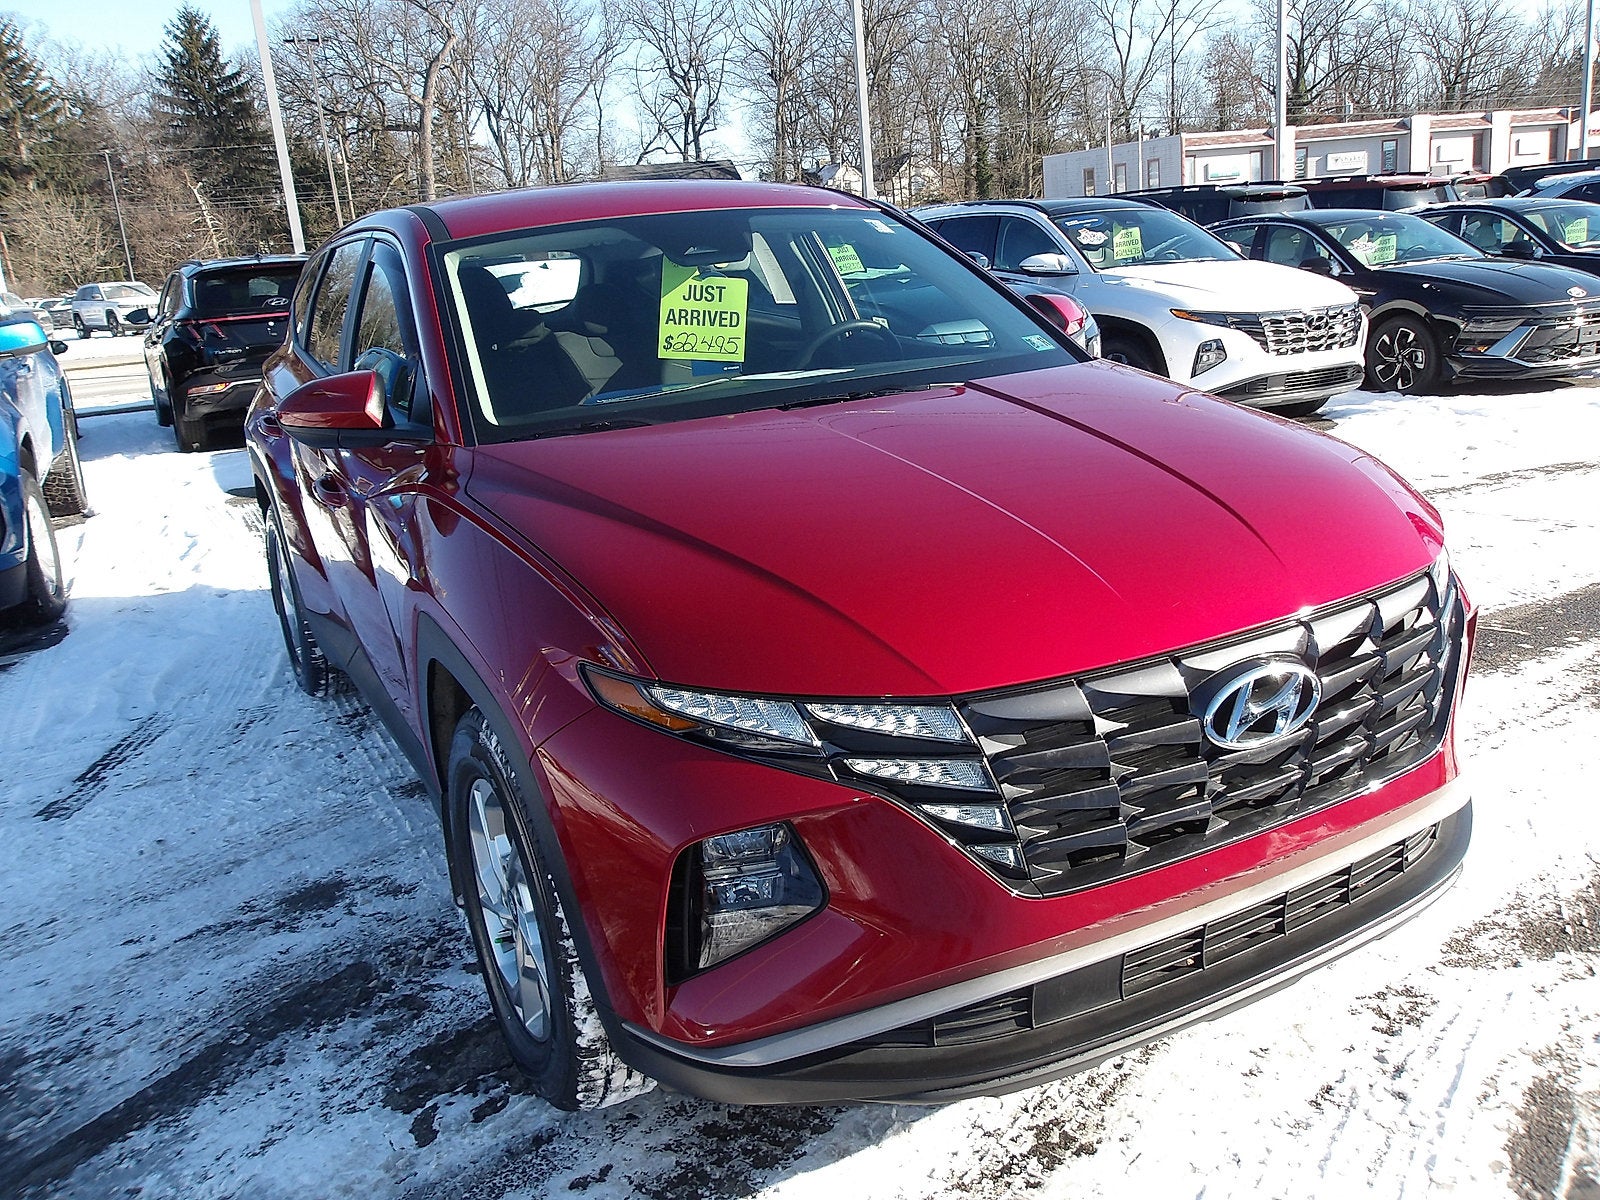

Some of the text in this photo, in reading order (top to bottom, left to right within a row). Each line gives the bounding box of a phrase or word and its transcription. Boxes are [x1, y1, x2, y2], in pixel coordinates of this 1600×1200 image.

[1120, 231, 1133, 240] JUST
[1115, 238, 1139, 248] ARRIVED
[836, 246, 850, 254] JUST
[835, 254, 858, 263] ARRIVED
[682, 284, 727, 303] JUST
[664, 308, 741, 328] ARRIVED
